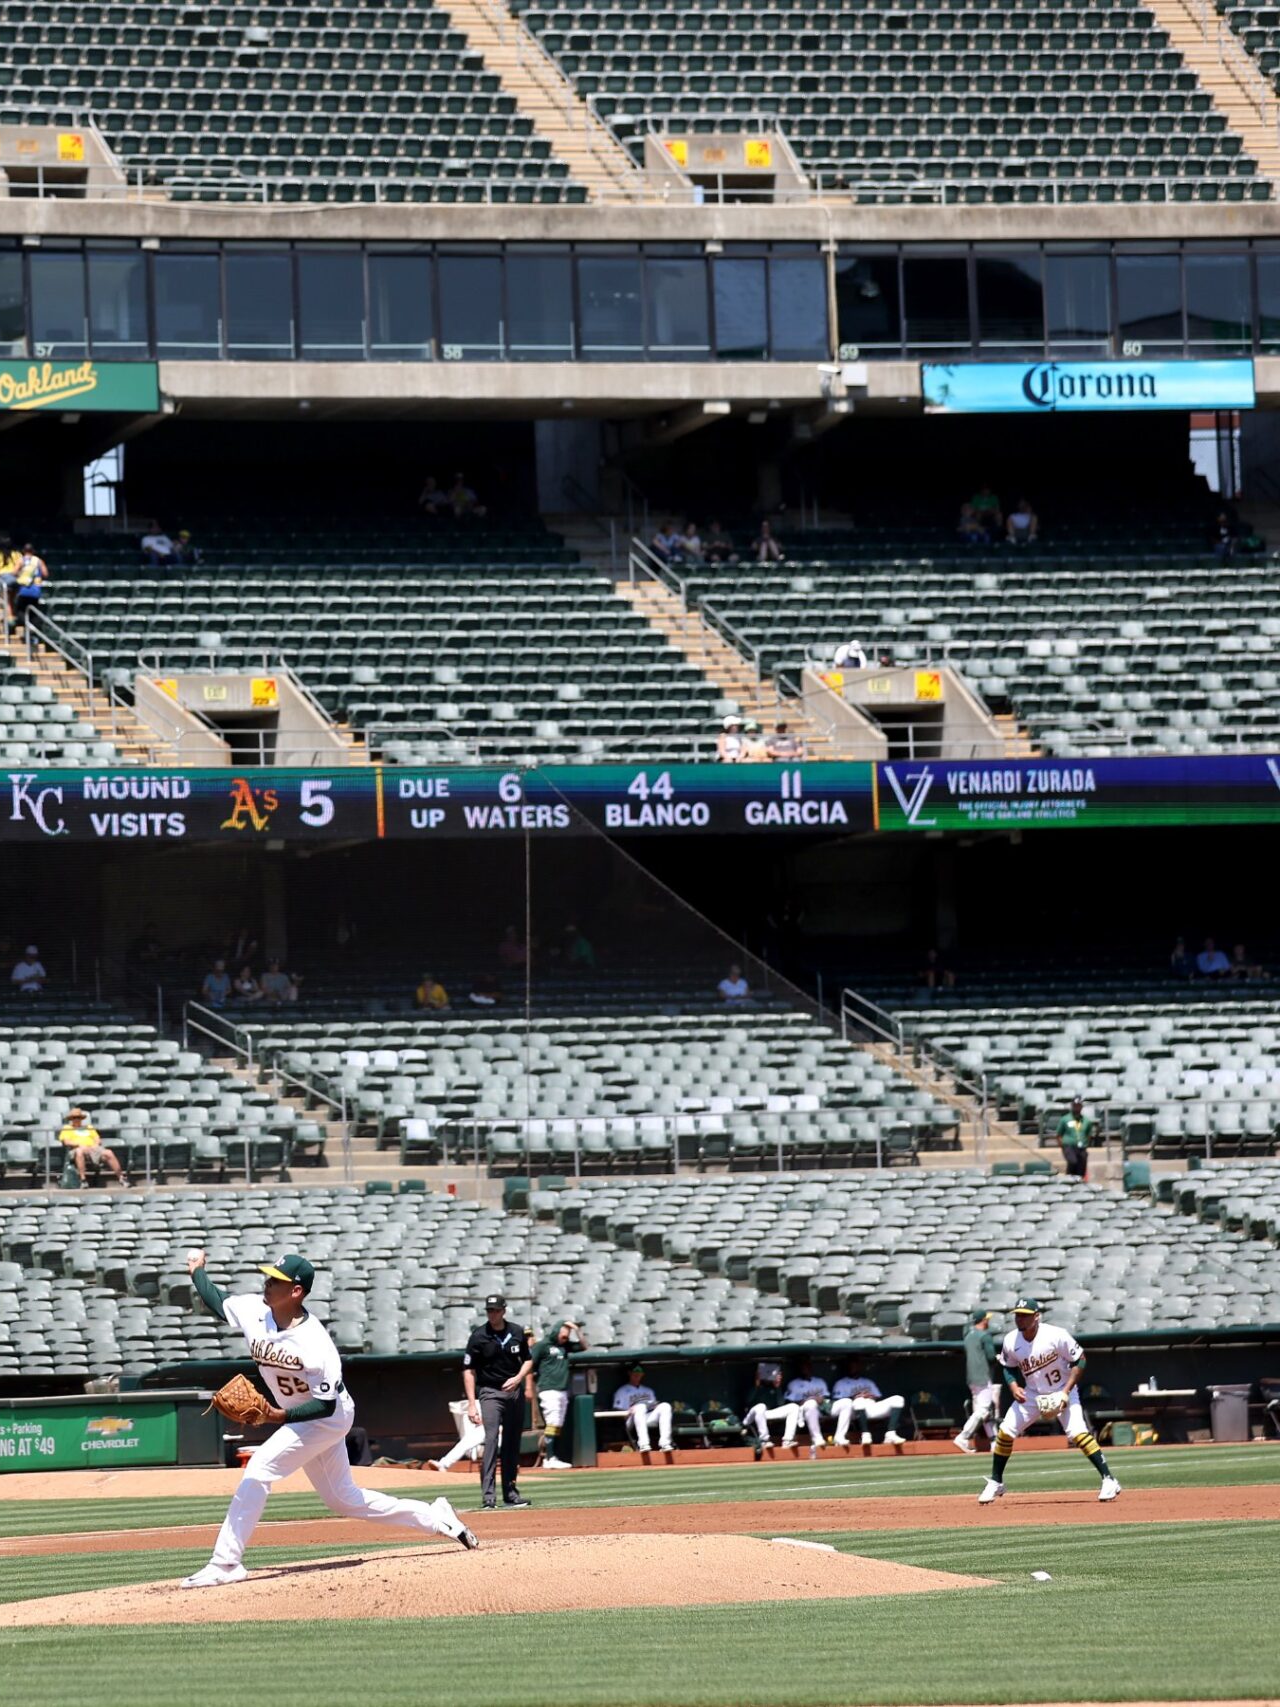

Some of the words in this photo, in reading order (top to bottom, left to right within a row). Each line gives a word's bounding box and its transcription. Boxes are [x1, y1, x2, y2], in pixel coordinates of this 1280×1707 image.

[34, 343, 55, 358] 57
[443, 344, 464, 360] 58
[839, 343, 859, 360] 59
[1122, 341, 1143, 356] 60
[1022, 361, 1158, 407] Corona
[82, 775, 191, 800] MOUND
[399, 778, 451, 800] DUE
[498, 772, 522, 803] 6
[627, 771, 675, 801] 44
[780, 770, 802, 800] 11
[946, 769, 1023, 796] VENARDI
[1025, 768, 1097, 794] ZURADA
[8, 773, 65, 836] KC
[299, 779, 335, 828] 5
[605, 802, 711, 828] BLANCO
[744, 800, 849, 827] GARCIA
[90, 812, 187, 837] VISITS
[410, 808, 446, 830] UP
[464, 804, 571, 830] WATERS
[276, 1374, 310, 1397] 55
[1044, 1369, 1062, 1387] 13
[12, 1422, 43, 1437] Parking
[18, 1437, 32, 1457] AT
[34, 1436, 56, 1456] $49
[80, 1437, 140, 1452] CHEVROLET
